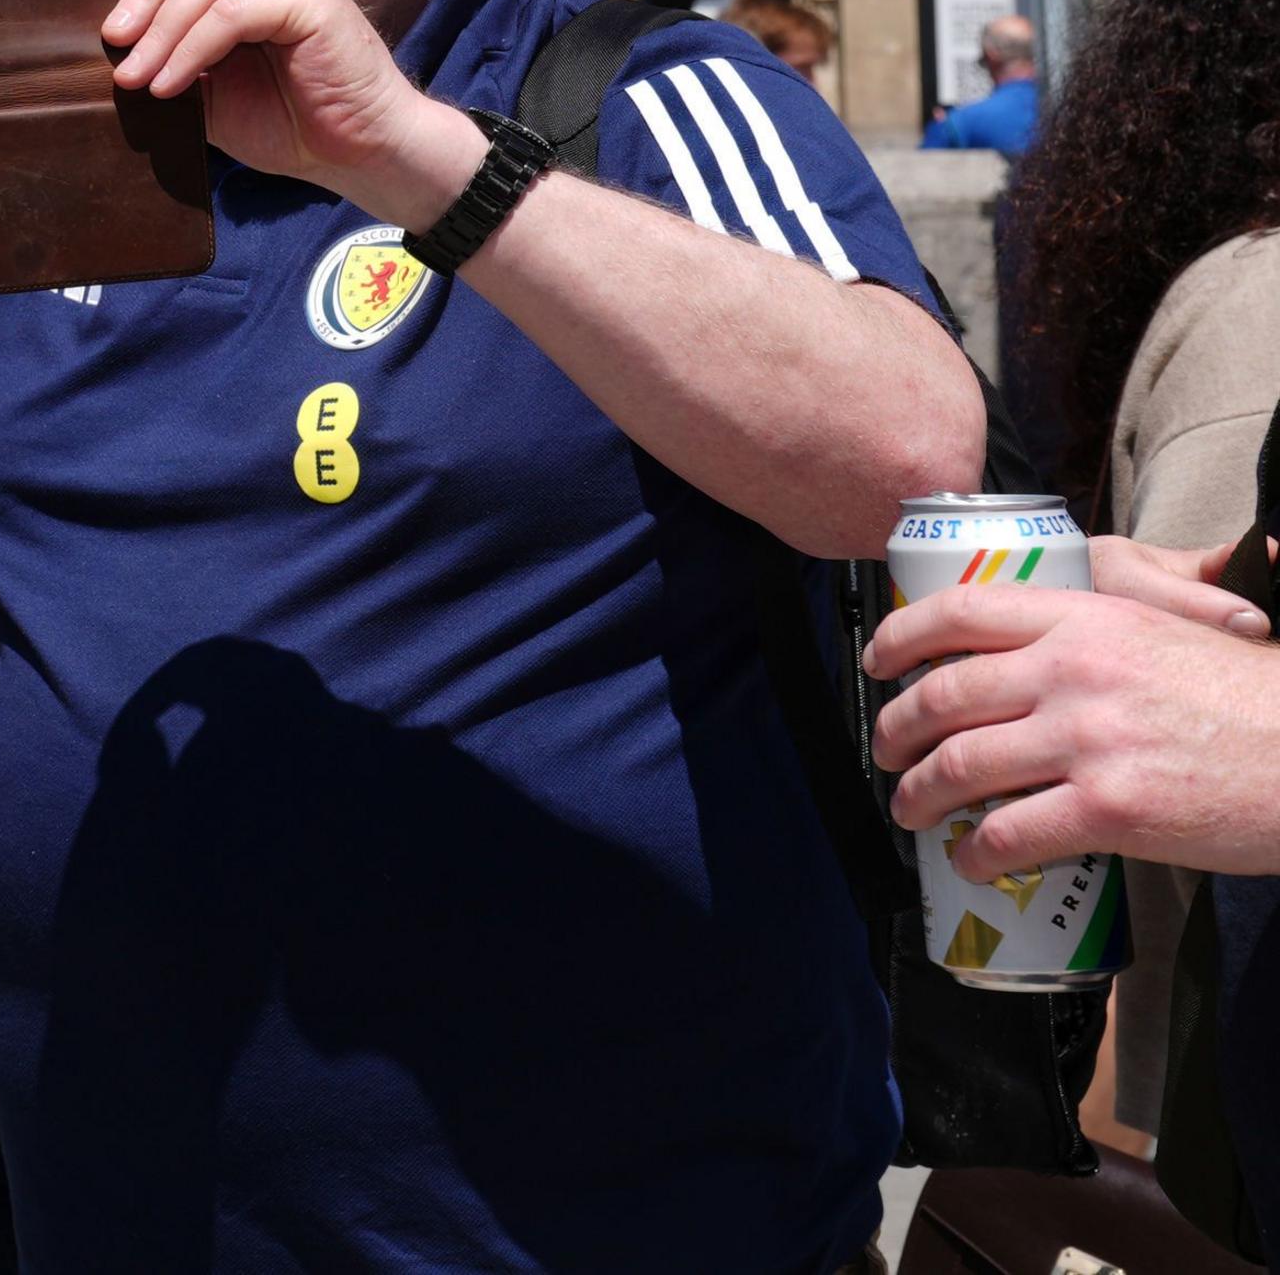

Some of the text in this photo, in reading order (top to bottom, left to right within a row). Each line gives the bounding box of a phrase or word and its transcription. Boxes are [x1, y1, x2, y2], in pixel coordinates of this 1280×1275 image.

[317, 322, 333, 339] EST
[902, 518, 962, 539] GAST
[1051, 853, 1097, 930] PREM
